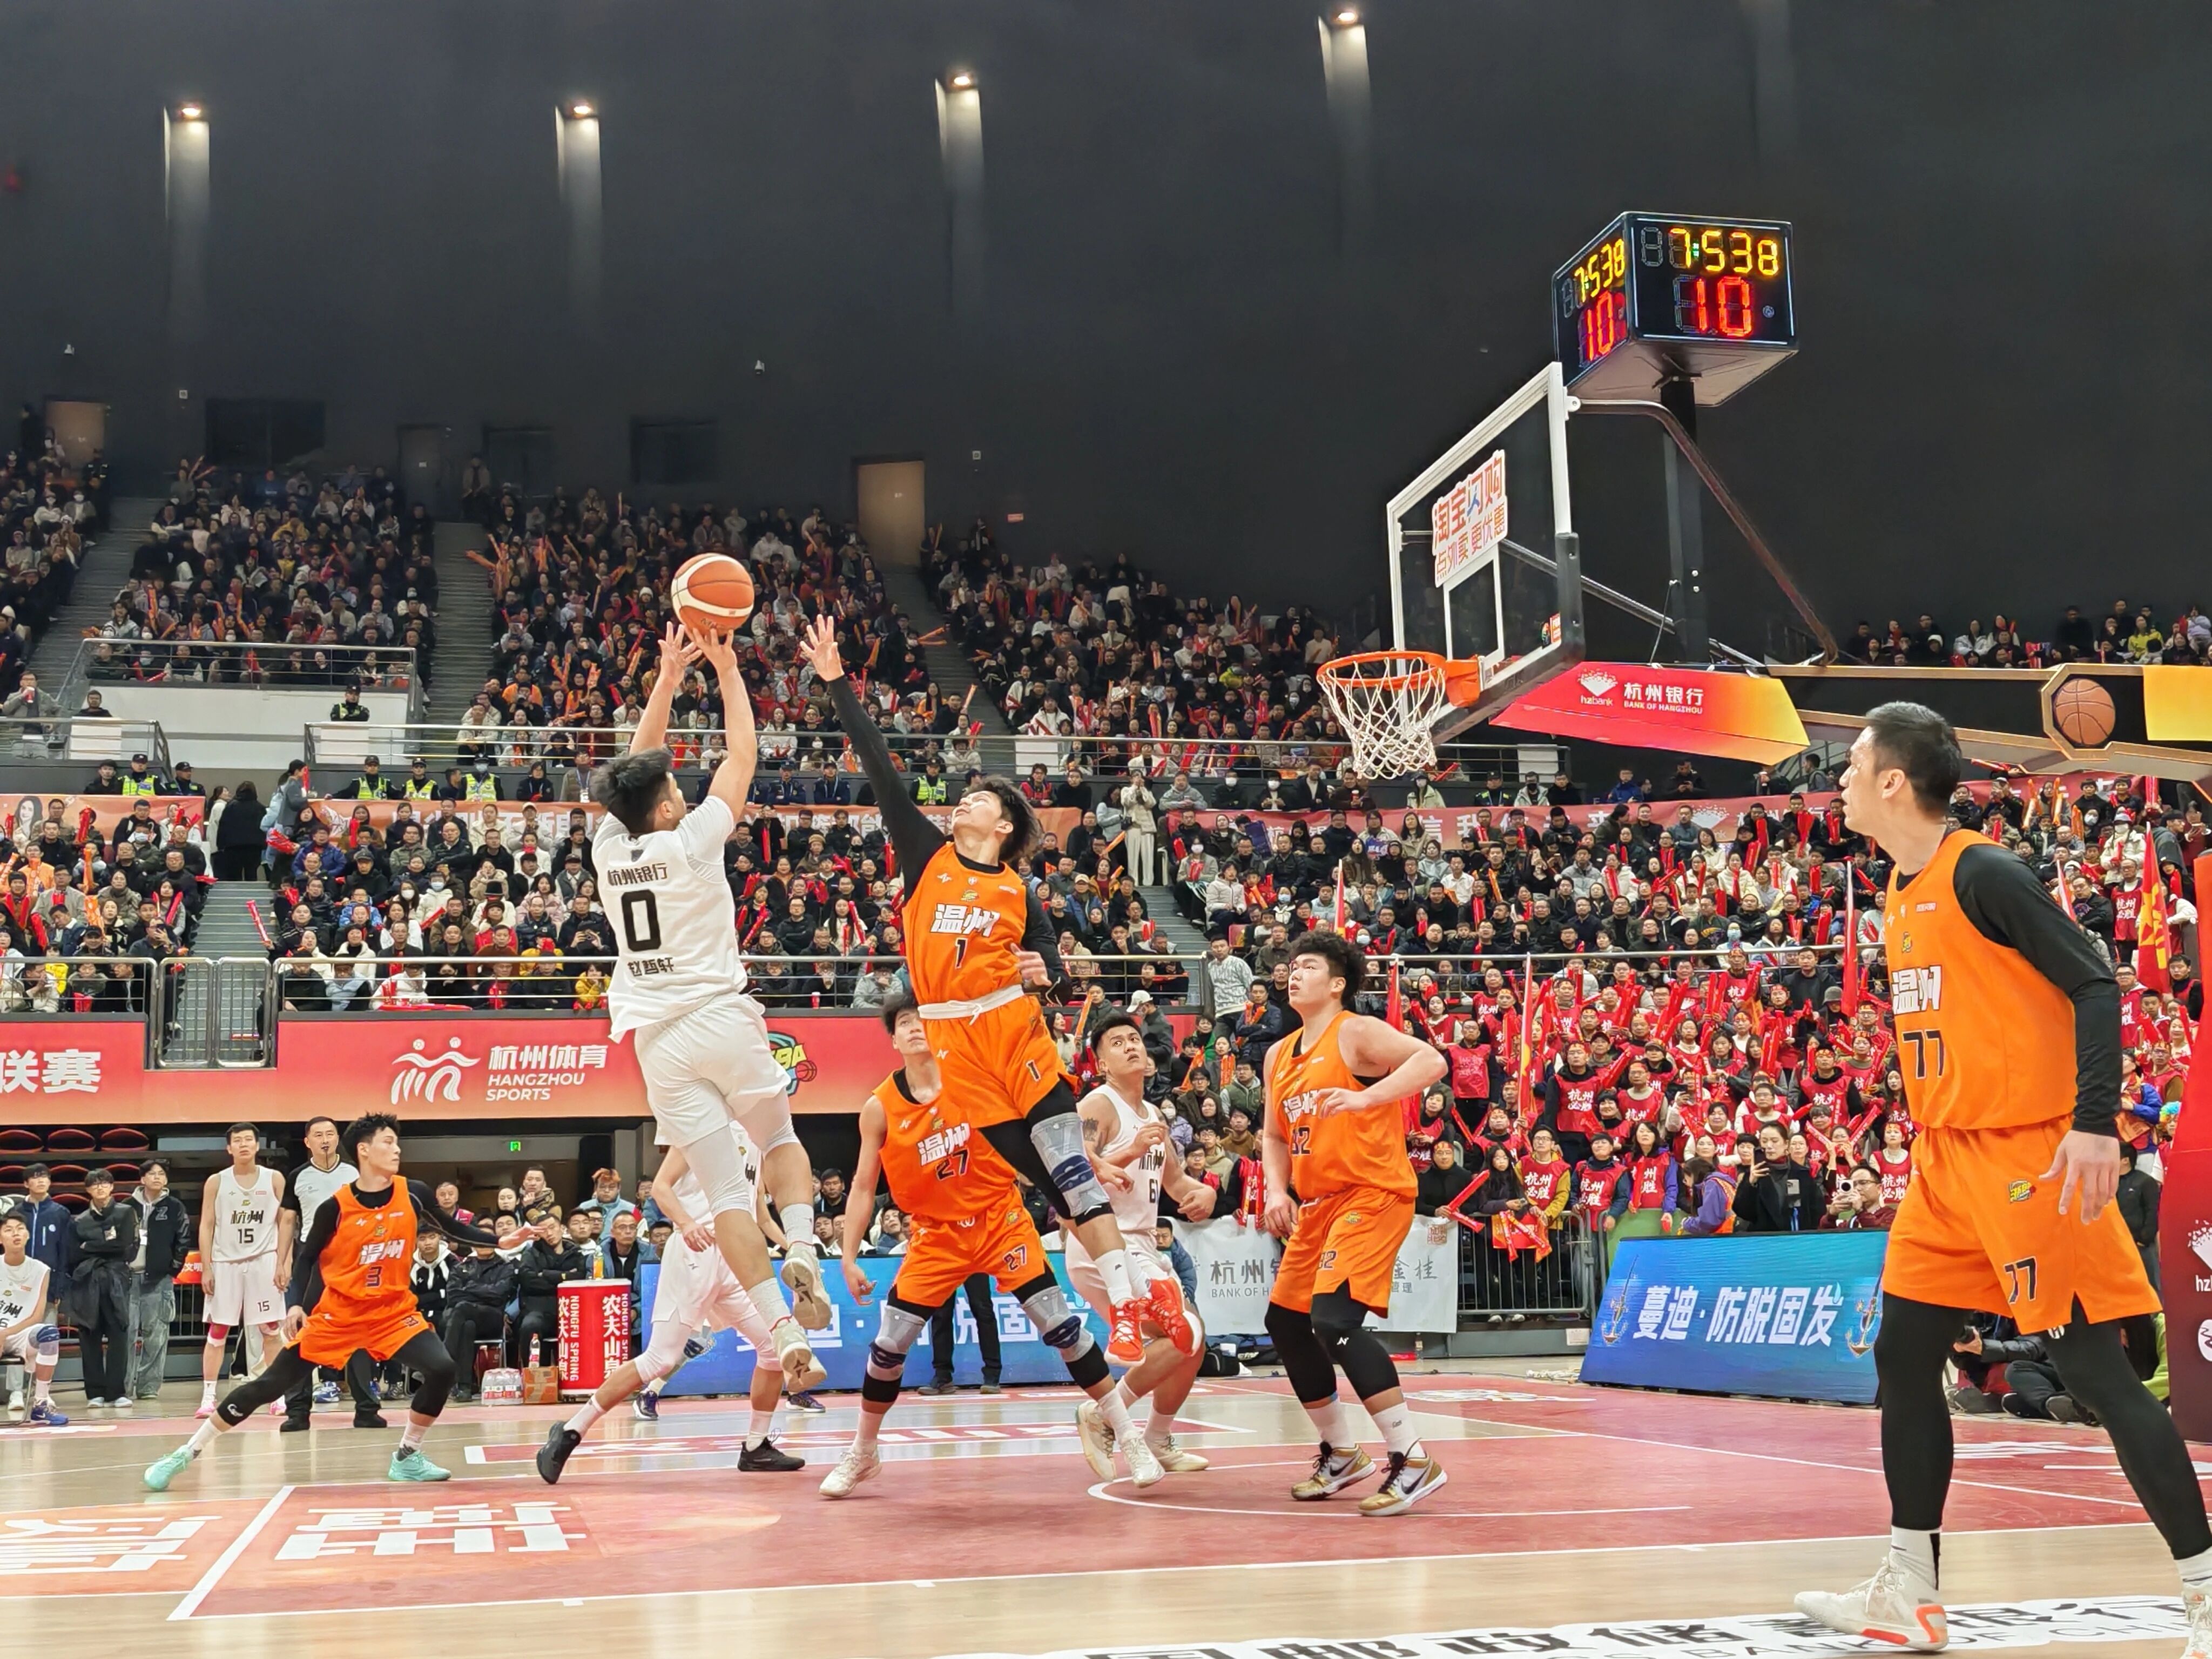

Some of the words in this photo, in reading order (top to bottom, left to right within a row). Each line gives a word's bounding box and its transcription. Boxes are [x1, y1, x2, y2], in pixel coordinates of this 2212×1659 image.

[1695, 276, 1753, 337] 10
[1583, 291, 1614, 362] 10
[1434, 456, 1503, 550] 淘宝闪购
[1580, 694, 1614, 706] hzbank
[1623, 682, 1704, 706] 杭州银行
[1624, 700, 1645, 710] BANK
[1647, 703, 1657, 711] OF
[1658, 704, 1703, 714] HANGZHOU
[606, 863, 668, 887] 杭州银行
[621, 889, 662, 952] 0
[930, 903, 1001, 937] 温州
[955, 937, 968, 969] 1
[1891, 965, 1943, 1016] 温州
[488, 1044, 608, 1071] 杭州体育
[1900, 1028, 1945, 1080] 77
[0, 1049, 102, 1094] 联赛
[488, 1072, 585, 1086] HANGZHOU
[1026, 1059, 1042, 1082] 1
[485, 1087, 551, 1102] SPORTS
[1568, 1088, 1594, 1101] 杭州
[1624, 1108, 1648, 1121] 杭州
[917, 1123, 970, 1166] 温州
[935, 1148, 969, 1181] 27
[1524, 1172, 1552, 1186] 杭州
[1580, 1177, 1604, 1192] 杭州
[1881, 1174, 1908, 1187] 杭州
[1526, 1186, 1550, 1200] 必胜
[1880, 1187, 1906, 1200] 必胜
[155, 1205, 168, 1220] Z
[230, 1209, 265, 1225] 杭州
[237, 1228, 254, 1244] 15
[359, 1239, 406, 1265] 温州
[1002, 1244, 1028, 1272] 27
[366, 1265, 383, 1288] 3
[1393, 1255, 1438, 1280] 金桂
[2003, 1255, 2038, 1304] 77
[1211, 1287, 1240, 1298] BANK
[1244, 1287, 1258, 1297] OF
[257, 1300, 270, 1312] 15
[570, 1295, 580, 1339] NONGFU
[1633, 1282, 1843, 1347] 蔓迪·防脱固发
[558, 1296, 570, 1381] 农夫山泉
[602, 1293, 621, 1380] 农夫山泉
[570, 1341, 579, 1382] SPRING
